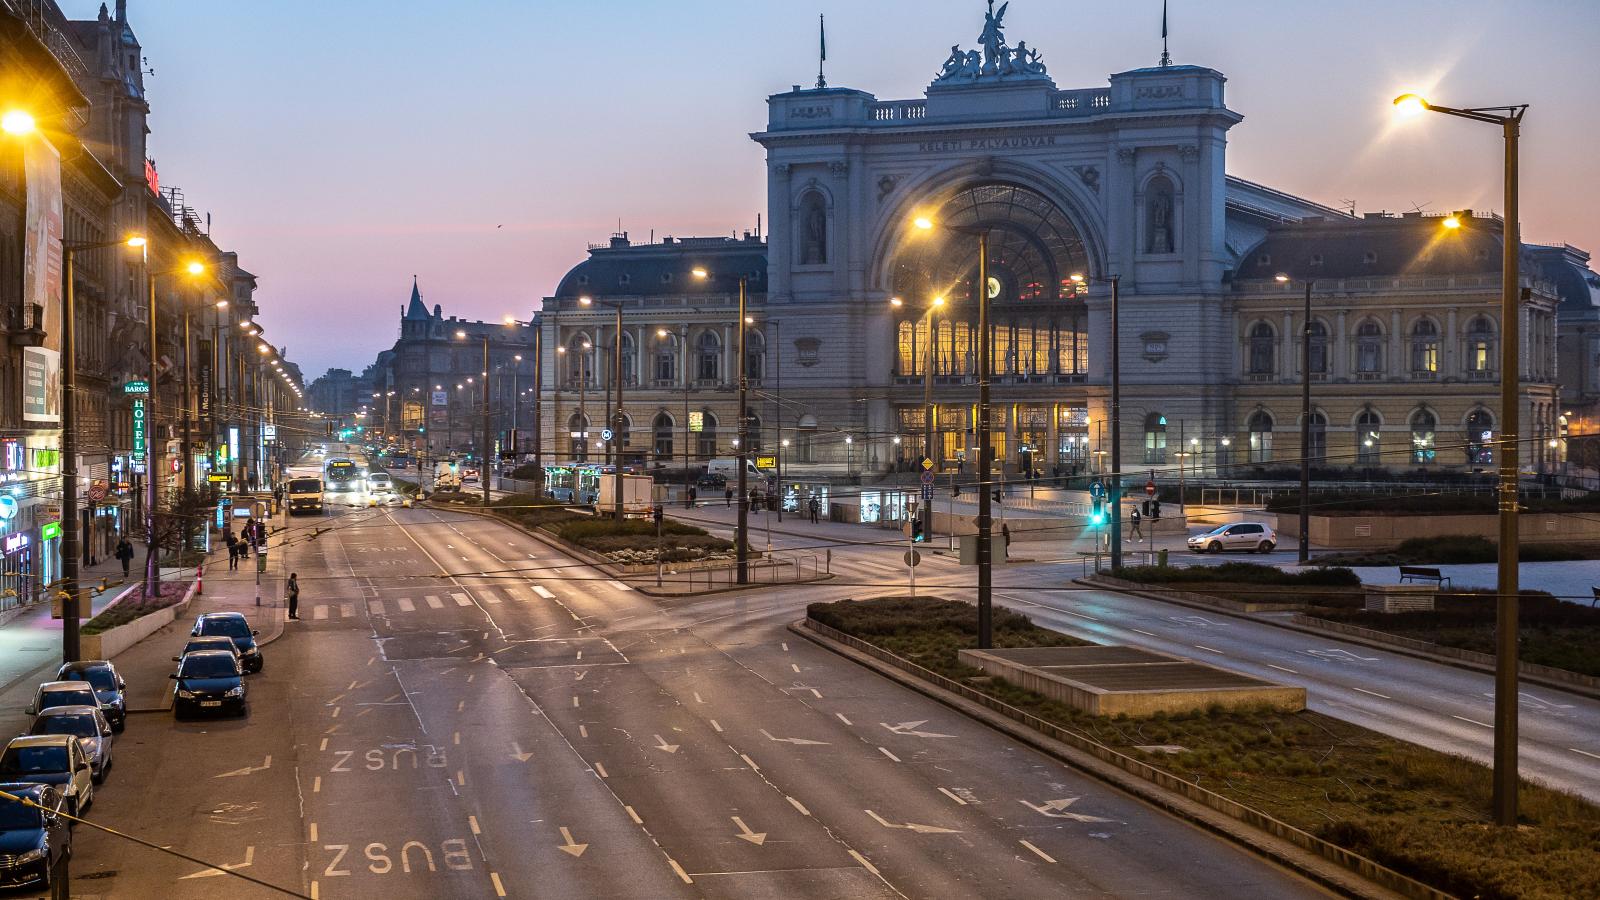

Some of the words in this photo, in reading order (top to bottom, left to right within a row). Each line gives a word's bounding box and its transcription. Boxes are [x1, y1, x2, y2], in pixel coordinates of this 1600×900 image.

[919, 142, 962, 153] KELETI
[134, 400, 144, 450] HOTEL
[329, 746, 448, 773] BUSZ
[323, 838, 474, 877] BUSZ
